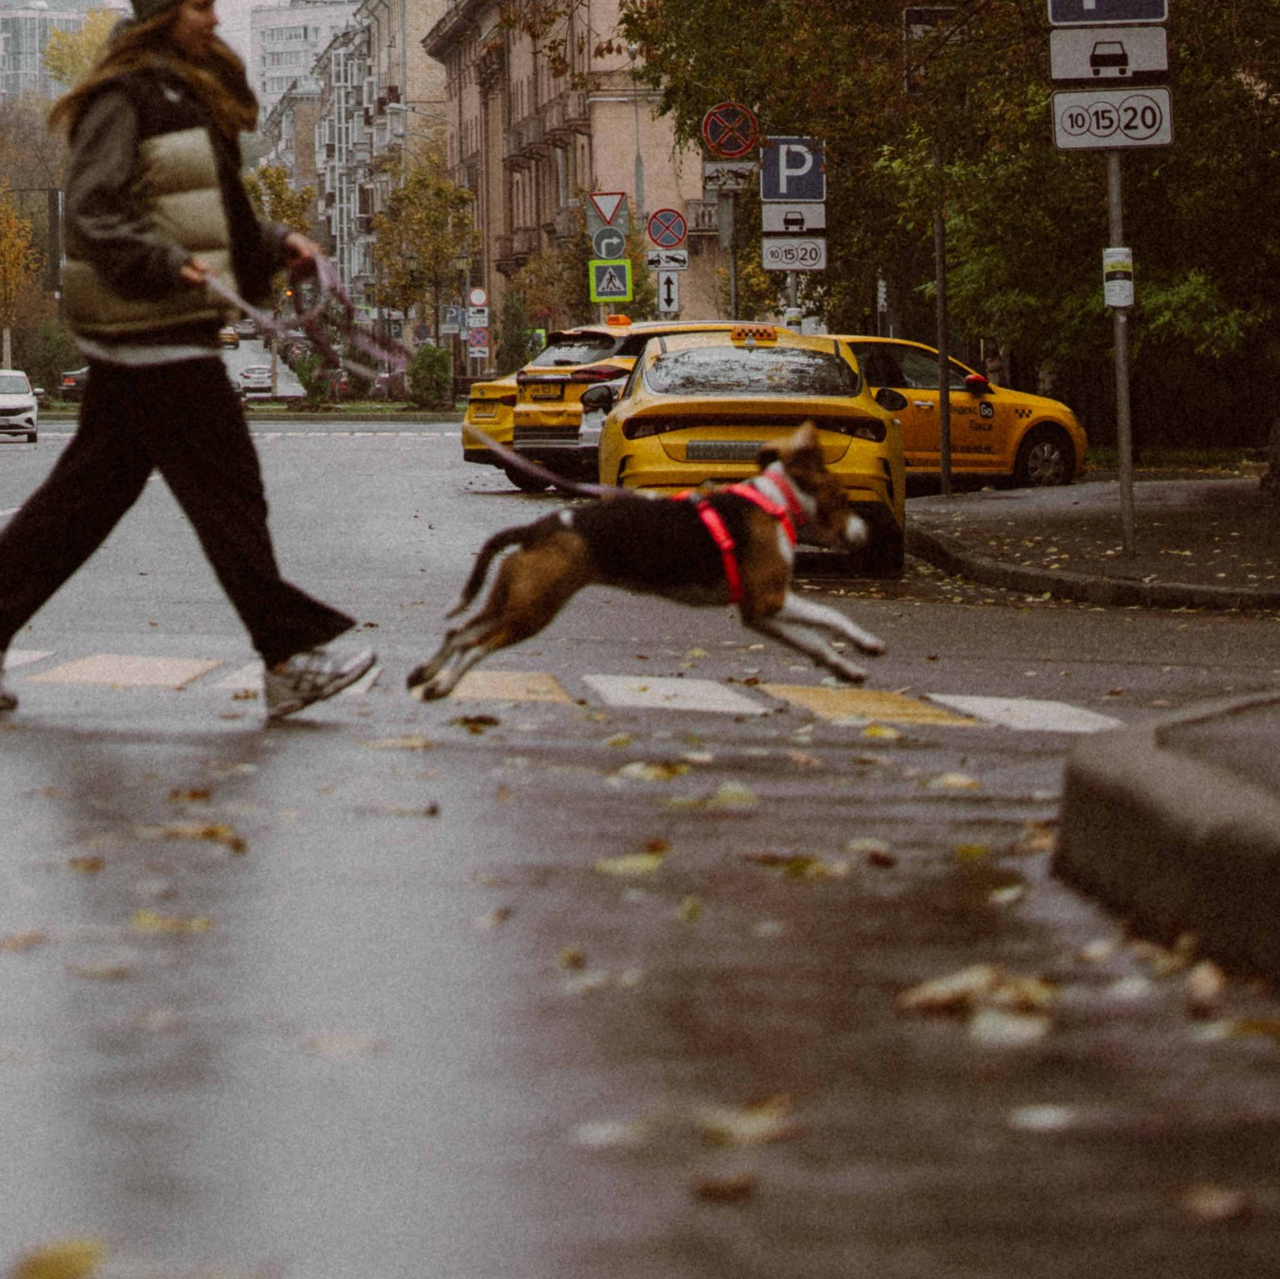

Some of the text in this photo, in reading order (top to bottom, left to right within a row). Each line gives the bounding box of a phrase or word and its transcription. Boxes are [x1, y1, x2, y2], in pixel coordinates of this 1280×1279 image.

[1068, 105, 1157, 131] 10 15 20
[779, 144, 813, 194] P
[770, 247, 818, 261] 10 15 20
[980, 404, 993, 417] Go
